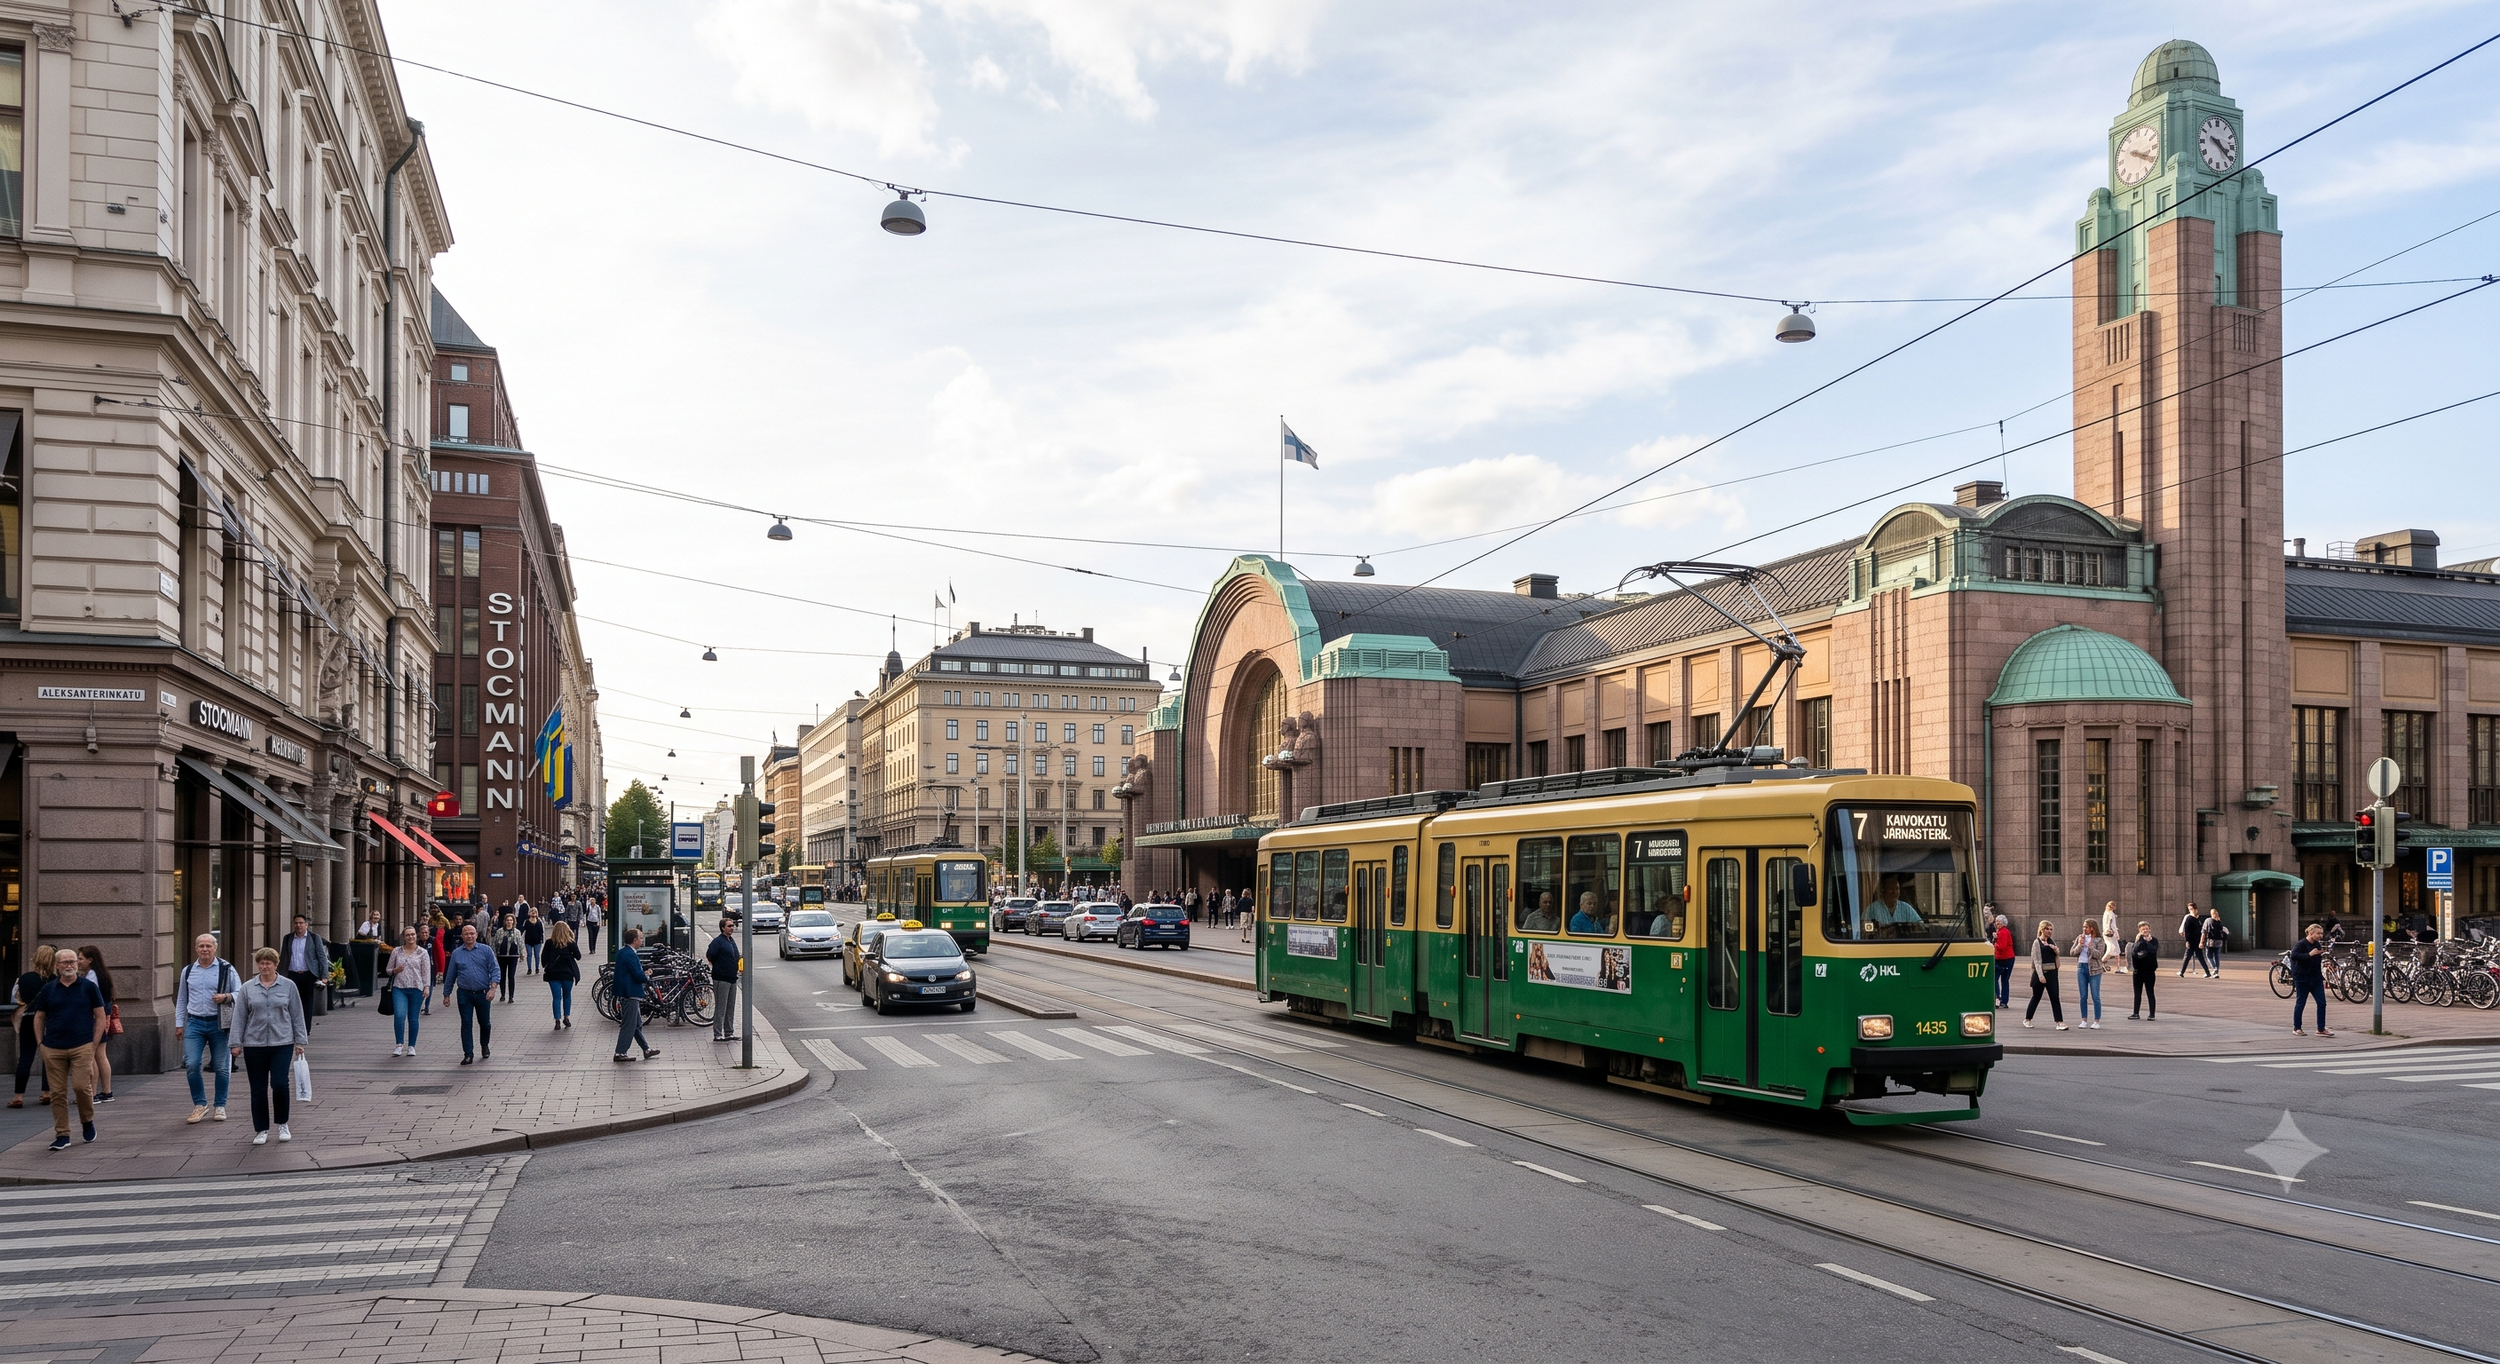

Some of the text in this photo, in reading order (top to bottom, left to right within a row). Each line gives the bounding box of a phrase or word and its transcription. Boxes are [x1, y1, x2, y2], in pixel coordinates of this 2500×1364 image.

[42, 688, 141, 699] ALEKSANTERINKATU
[486, 593, 514, 809] STOCMANN
[200, 700, 253, 740] STOCMANN
[1853, 813, 1947, 839] 7 KAIVOKATU
[1634, 841, 1642, 858] 7
[2432, 850, 2448, 872] P
[1879, 965, 1901, 976] HKL
[1916, 1021, 1947, 1035] 1435
